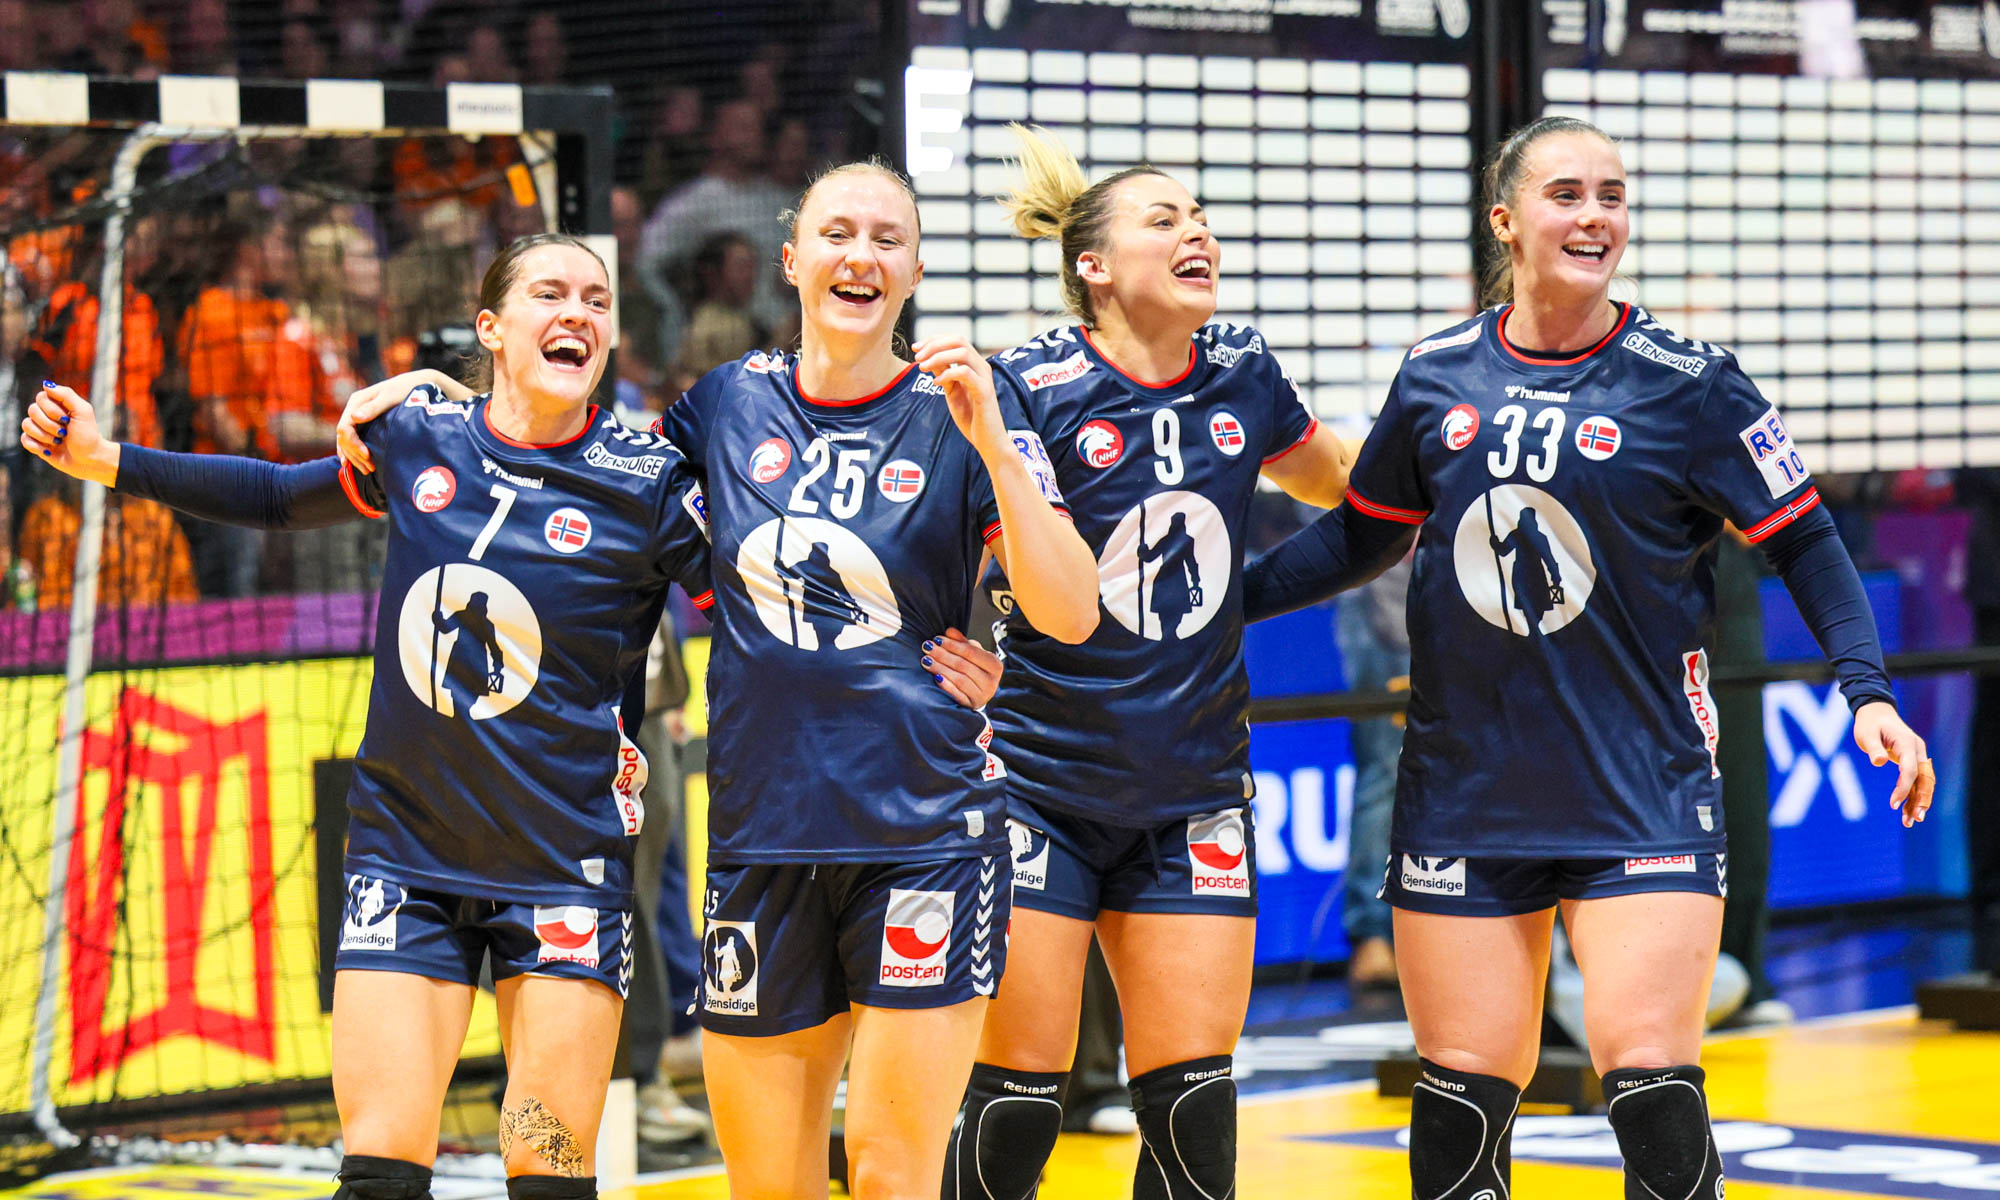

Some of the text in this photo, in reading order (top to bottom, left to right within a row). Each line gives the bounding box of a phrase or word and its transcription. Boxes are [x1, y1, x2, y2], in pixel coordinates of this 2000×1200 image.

[1626, 334, 1704, 376] GJENSIDIGE
[1520, 387, 1571, 403] hummel
[1098, 449, 1119, 463] NHF
[1152, 408, 1185, 486] 9
[1455, 432, 1473, 444] NHF
[1487, 405, 1567, 483] 33
[1748, 411, 1789, 462] RE
[788, 437, 871, 520] 25
[1776, 448, 1810, 487] 10
[467, 484, 518, 562] 7
[616, 748, 639, 833] posten
[1194, 874, 1248, 890] posten
[1403, 873, 1463, 892] Gjensidige
[881, 963, 944, 981] posten
